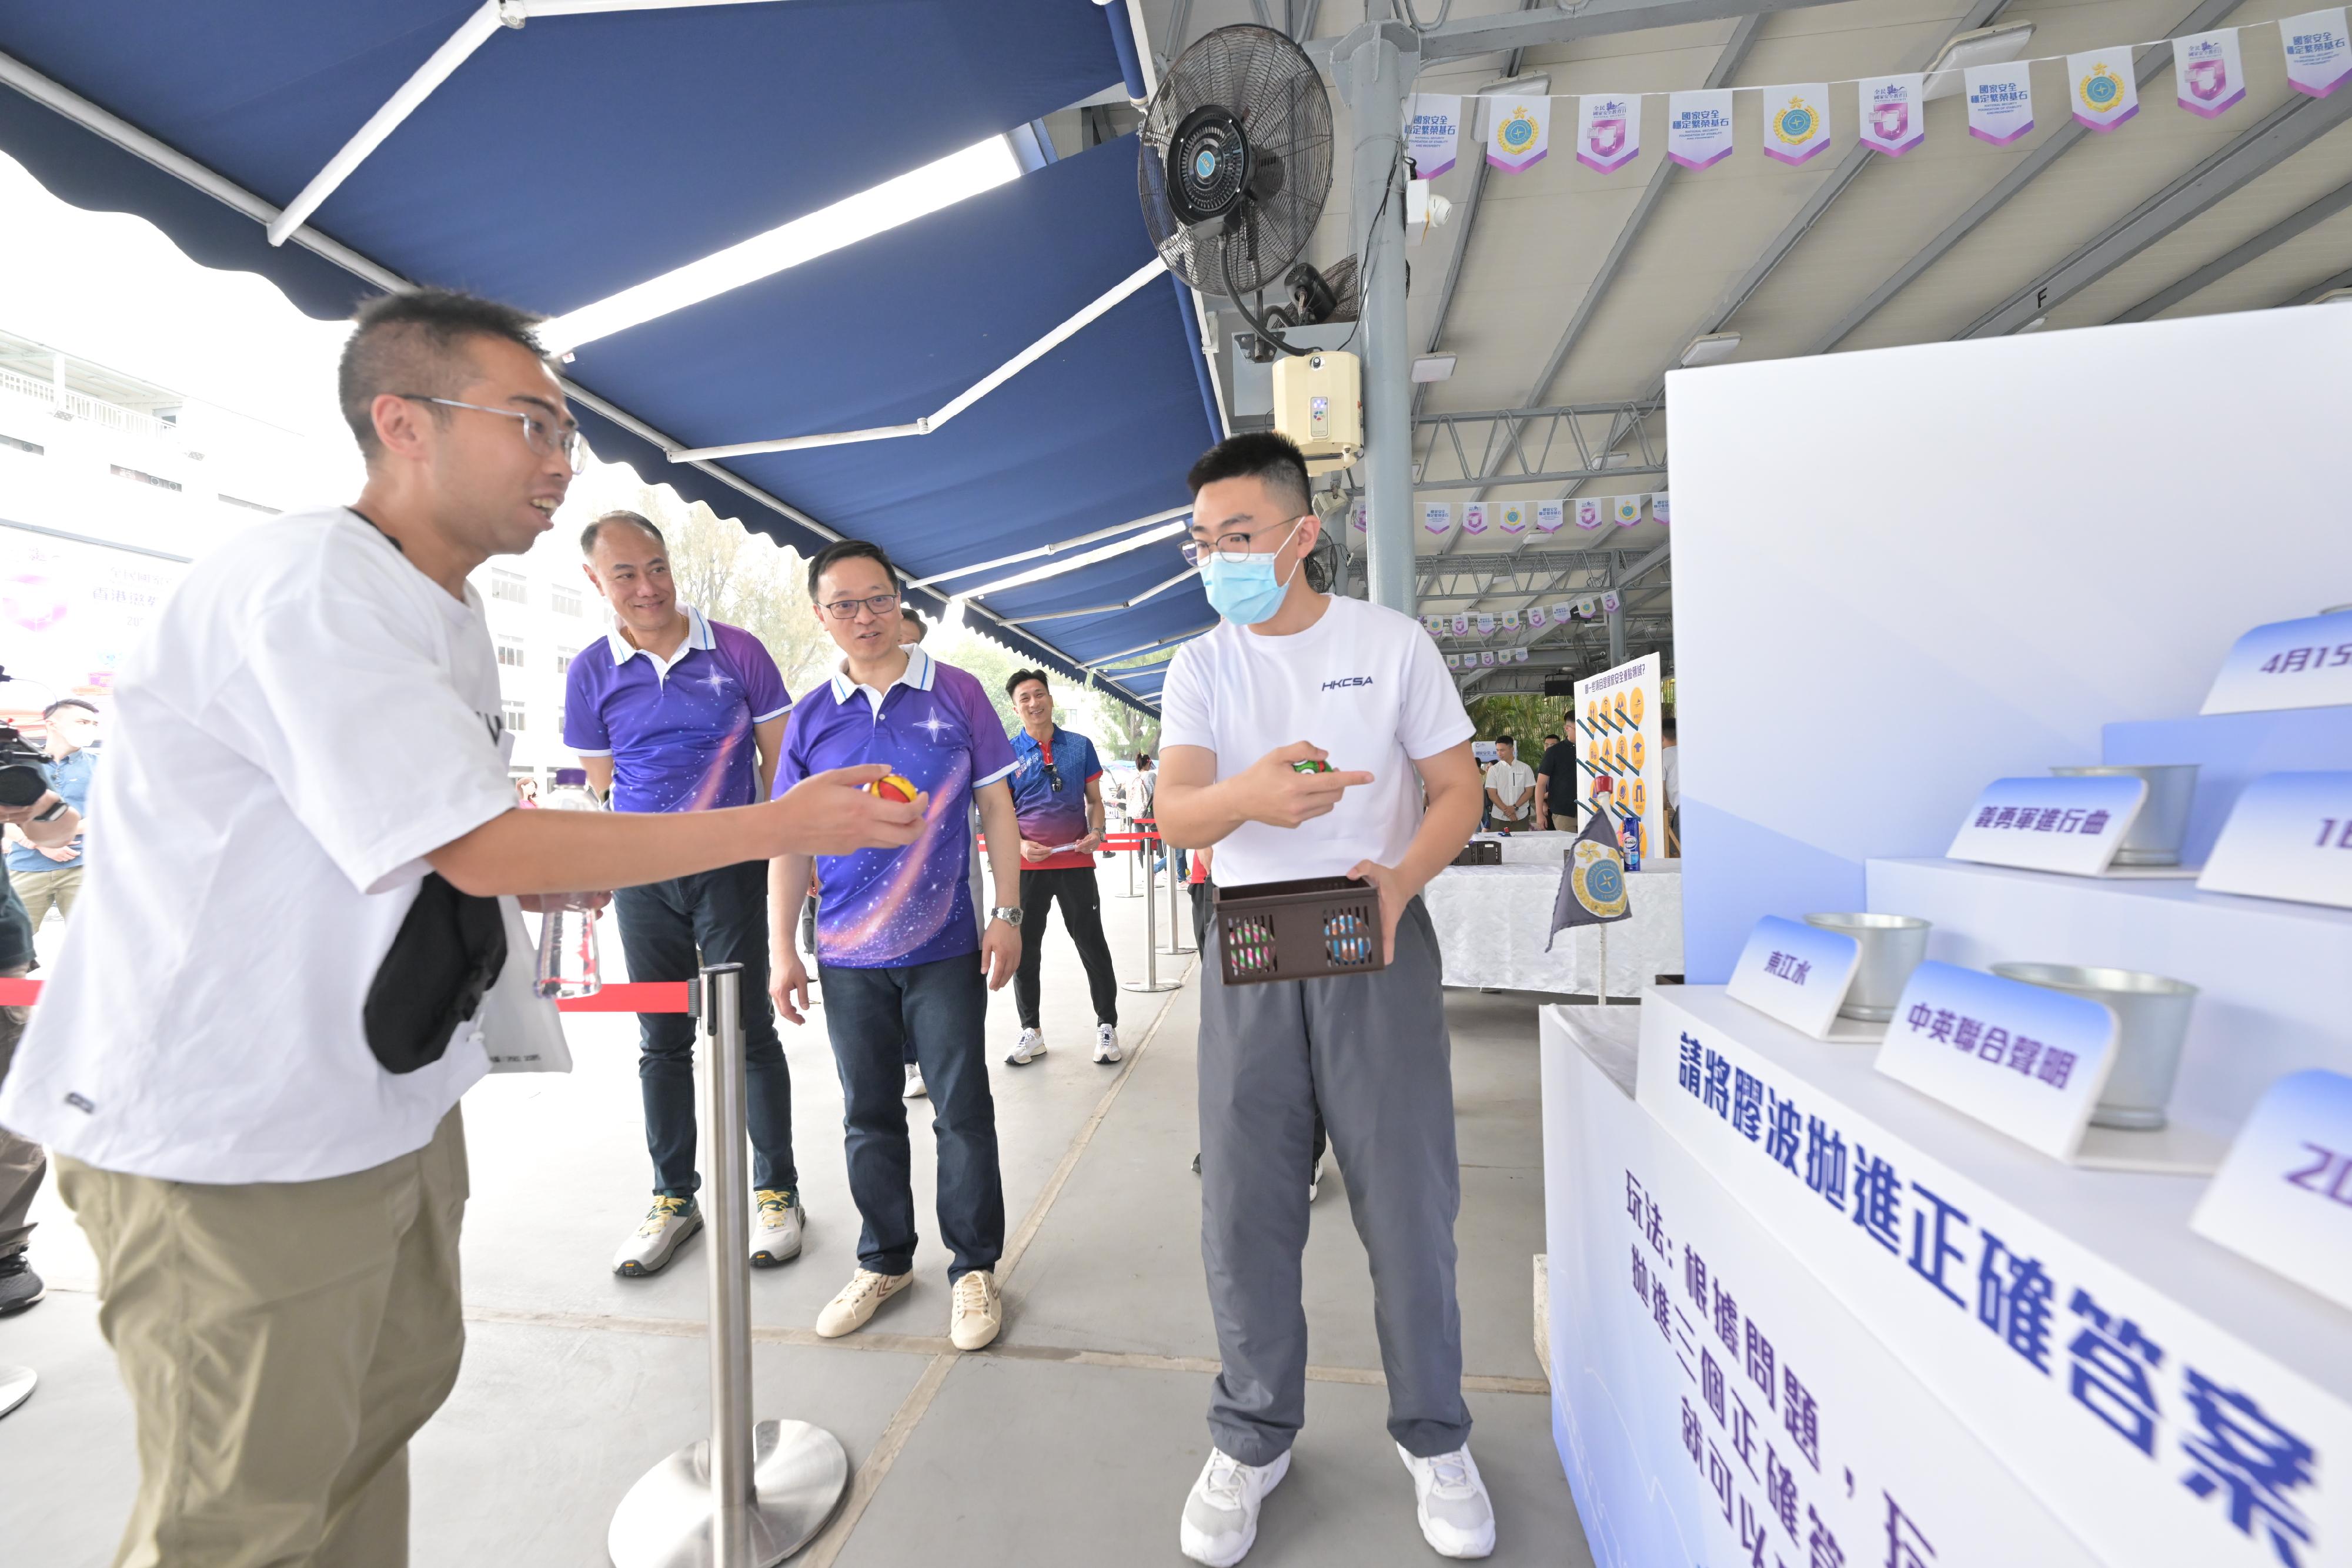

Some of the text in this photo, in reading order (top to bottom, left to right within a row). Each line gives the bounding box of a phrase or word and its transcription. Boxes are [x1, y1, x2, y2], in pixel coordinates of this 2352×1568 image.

[2293, 32, 2331, 46] 國家安全
[1979, 83, 2016, 94] 國家安全
[1970, 91, 2028, 103] 穩定繁榮基石
[1414, 115, 1448, 125] 國家安全
[1682, 110, 1719, 120] 國家安全
[1672, 118, 1729, 129] 穩定繁榮基石
[2037, 287, 2047, 309] F
[1322, 676, 1373, 691] HKCSA
[1975, 806, 2111, 834] 義勇軍進行曲
[1764, 951, 1812, 985] 東江水
[1907, 1002, 2079, 1090] 中英聯合聲明
[1679, 1030, 2320, 1568] 請將膠波拋進正確答案
